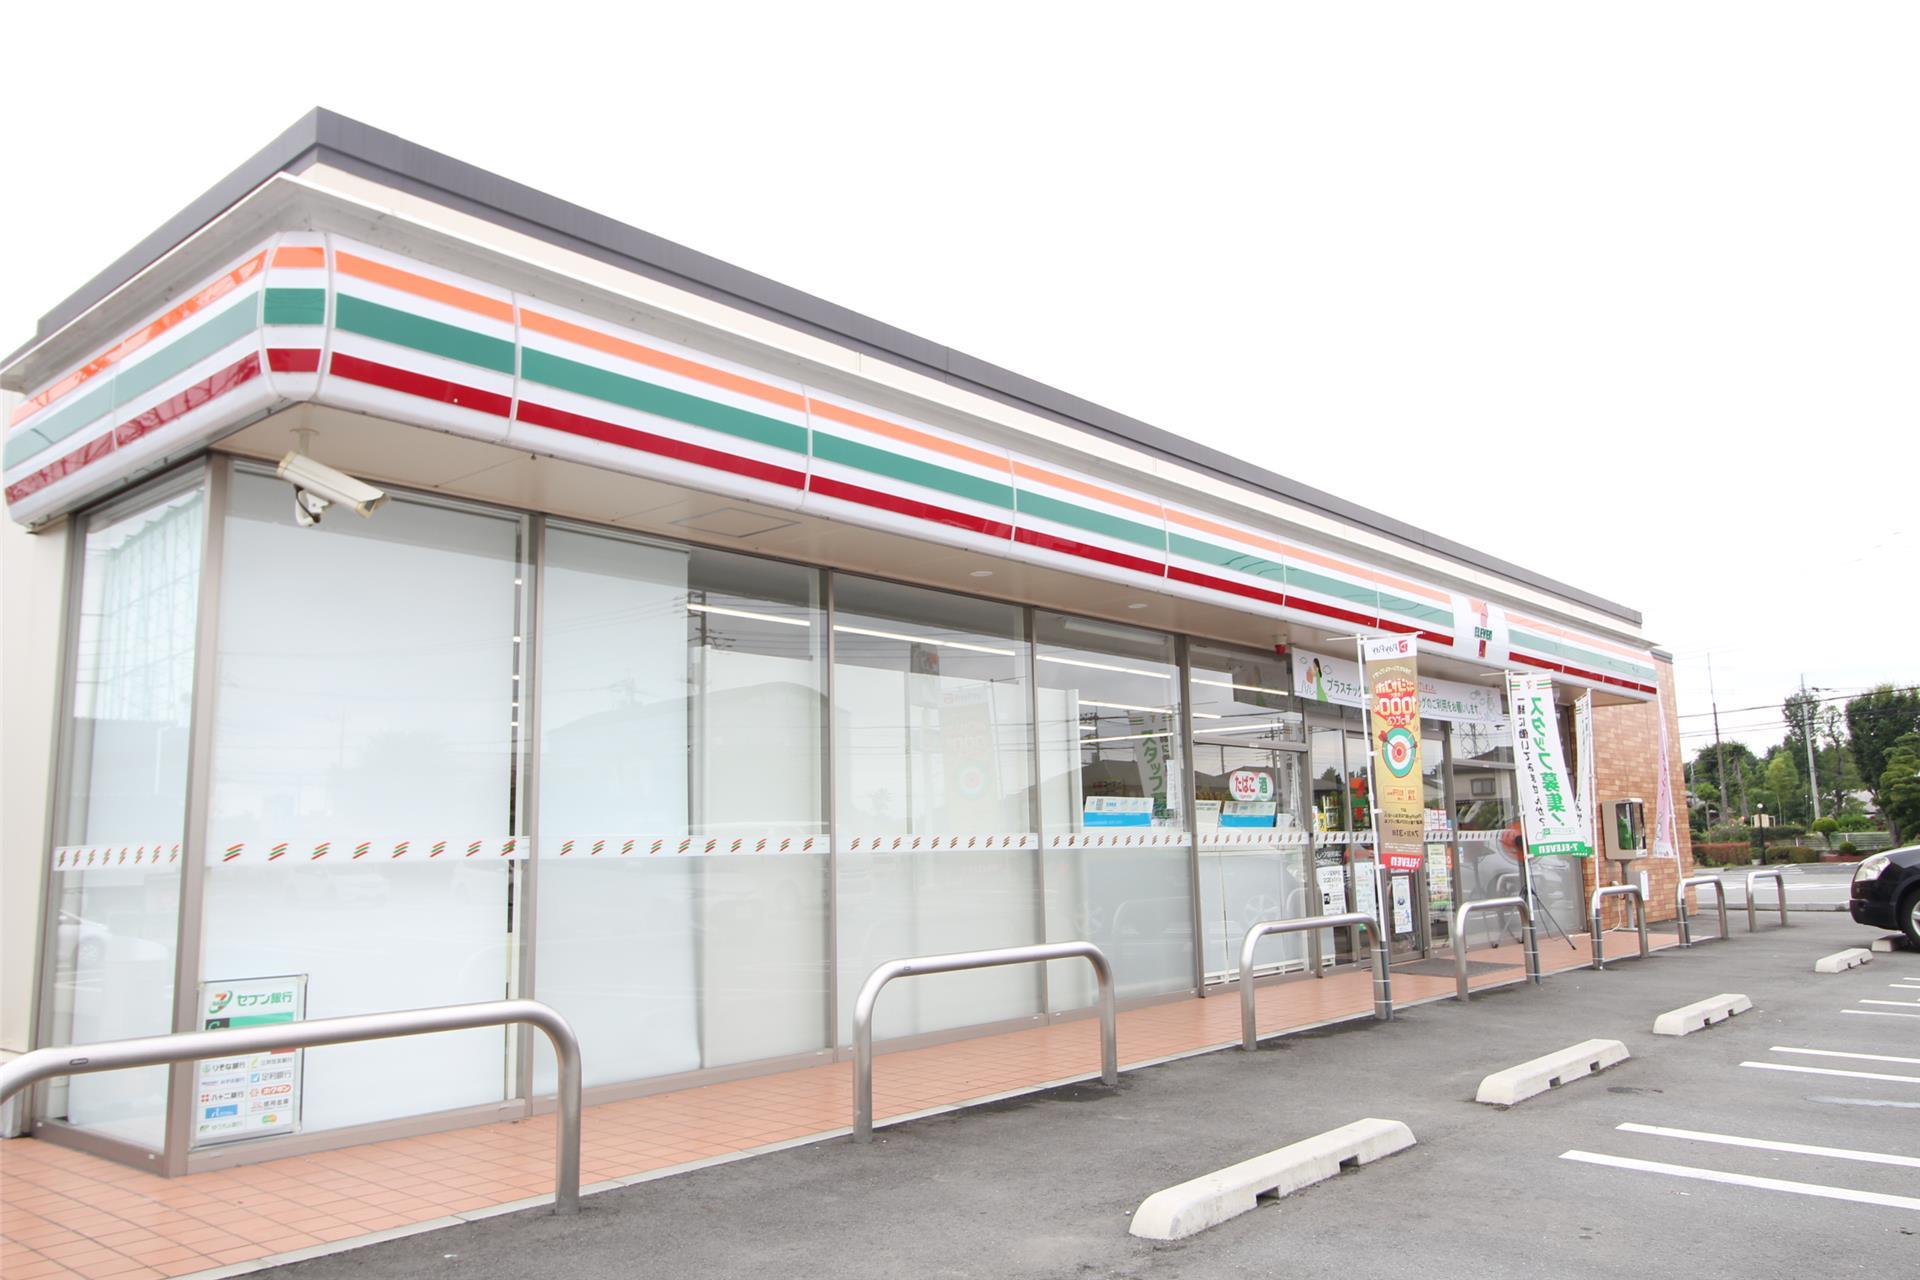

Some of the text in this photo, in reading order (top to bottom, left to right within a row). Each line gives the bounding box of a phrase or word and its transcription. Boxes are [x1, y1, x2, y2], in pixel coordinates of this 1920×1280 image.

[1235, 775, 1256, 793] たばこ
[237, 991, 293, 1006] セブン銀行
